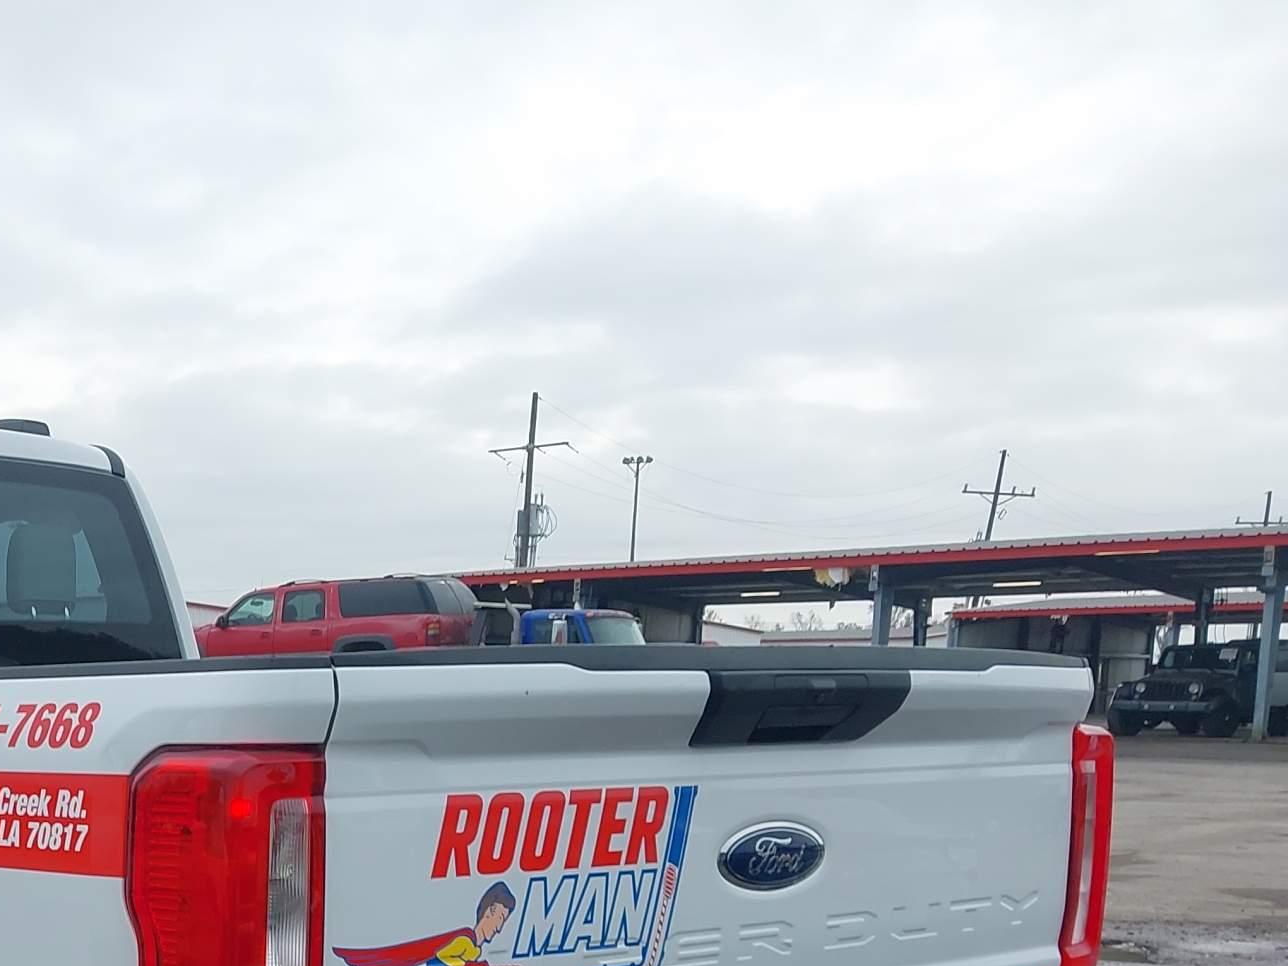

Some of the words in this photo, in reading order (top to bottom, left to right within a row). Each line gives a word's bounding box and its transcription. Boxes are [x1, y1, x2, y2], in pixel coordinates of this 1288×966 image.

[54, 789, 87, 819] Rd.
[26, 822, 89, 852] 70817
[430, 786, 670, 880] ROOTER
[748, 837, 807, 876] Ford
[512, 868, 658, 959] MAN
